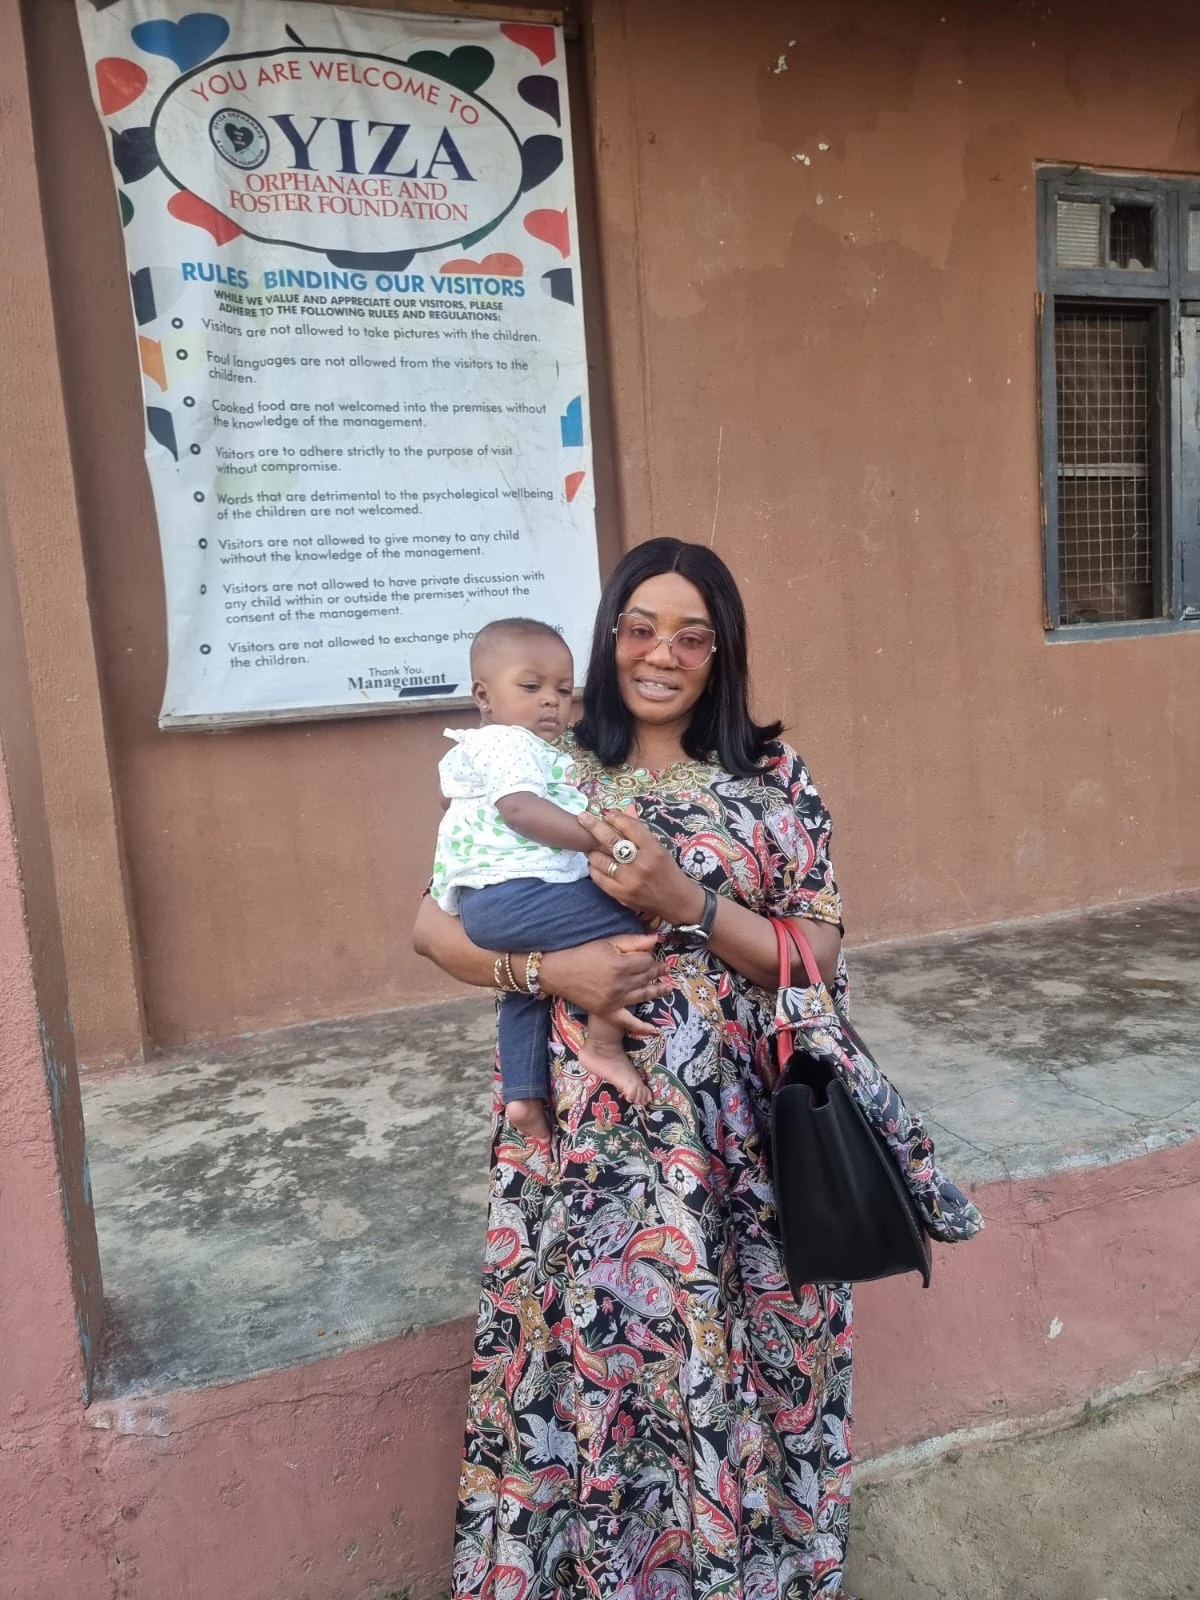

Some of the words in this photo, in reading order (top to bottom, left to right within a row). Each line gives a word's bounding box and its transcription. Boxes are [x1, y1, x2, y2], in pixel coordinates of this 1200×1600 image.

[191, 69, 247, 102] YOU
[258, 60, 302, 87] ARE
[309, 60, 441, 105] WELCOME
[449, 94, 479, 125] TO
[267, 113, 478, 182] YIZA
[246, 172, 393, 198] ORPHANAGE
[398, 181, 448, 201] AND
[229, 189, 313, 214] FOSTER
[318, 196, 468, 222] FOUNDATION
[181, 262, 249, 289] RULES
[263, 269, 368, 291] BINDING
[375, 273, 425, 293] OUR
[430, 275, 525, 297] VISITORS
[214, 289, 243, 304] WHILE
[246, 296, 263, 306] WE
[265, 293, 300, 304] VALUE
[303, 295, 327, 305] AND
[330, 296, 391, 308] APPRECIATE
[393, 299, 417, 309] OUR
[420, 299, 467, 310] VISITORS,
[469, 301, 503, 311] PLEASE
[219, 302, 257, 318] ADHERE
[260, 307, 274, 317] TO
[277, 305, 297, 315] THE
[300, 306, 366, 317] FOLLOWING
[368, 309, 400, 319] RULES
[402, 310, 426, 320] AND
[201, 317, 242, 337] Visitors
[246, 328, 266, 338] are
[270, 324, 291, 335] not
[295, 323, 344, 336] allowed
[348, 326, 360, 337] to
[364, 327, 389, 338] take
[393, 327, 440, 341] pictures
[443, 328, 468, 340] with
[471, 329, 489, 341] the
[493, 329, 541, 342] children.
[206, 350, 230, 365] Foul
[232, 354, 297, 371] languages
[300, 357, 321, 367] are
[325, 356, 345, 367] not
[349, 355, 396, 368] allowed
[400, 356, 428, 369] from
[432, 357, 450, 369] the
[454, 357, 493, 370] visitors
[496, 360, 507, 370] to
[511, 359, 529, 371] the
[208, 367, 257, 384] children.
[211, 399, 254, 414] Cooked
[258, 400, 286, 412] food
[290, 402, 311, 412] are
[315, 401, 334, 412] not
[338, 400, 400, 412] welcomed
[404, 401, 426, 413] into
[430, 401, 448, 413] the
[452, 402, 503, 415] premises
[506, 402, 547, 414] without
[213, 415, 229, 428] the
[232, 414, 299, 429] knowledge
[302, 415, 315, 427] of
[319, 415, 338, 427] the
[343, 417, 427, 429] management.
[215, 446, 255, 460] Visitors
[258, 447, 279, 457] are
[283, 446, 295, 457] to
[299, 445, 343, 457] adhere
[347, 445, 385, 459] strictly
[388, 446, 400, 456] to
[404, 446, 423, 456] the
[427, 447, 473, 459] purpose
[477, 444, 488, 456] of
[491, 445, 513, 456] visit
[216, 462, 257, 475] without
[261, 460, 342, 474] compromise.
[216, 492, 253, 506] Words
[257, 491, 281, 502] that
[285, 492, 306, 502] are
[311, 489, 381, 502] detrimental
[384, 490, 396, 500] to
[400, 489, 418, 500] the
[423, 488, 499, 502] psychological
[502, 488, 554, 501] wellbeing
[216, 508, 229, 520] of
[232, 508, 251, 520] the
[255, 505, 306, 517] children
[310, 507, 331, 516] are
[335, 505, 355, 516] not
[359, 504, 422, 515] welcomed.
[218, 538, 263, 550] Visitors
[267, 538, 289, 547] are
[292, 537, 313, 547] not
[316, 534, 365, 546] allowed
[369, 535, 381, 545] to
[384, 534, 408, 546] give
[412, 534, 451, 546] money
[455, 532, 466, 542] to
[470, 532, 490, 543] any
[493, 530, 520, 541] child
[220, 551, 267, 565] without
[271, 551, 291, 563] the
[295, 549, 363, 562] knowledge
[366, 548, 379, 559] of
[382, 548, 400, 559] the
[404, 546, 485, 559] management.
[222, 582, 268, 594] Visitors
[272, 583, 293, 592] are
[297, 581, 317, 591] not
[321, 578, 369, 590] allowed
[373, 578, 385, 588] to
[389, 576, 417, 588] have
[421, 575, 460, 588] private
[463, 572, 519, 584] discussion
[522, 570, 545, 582] with
[224, 600, 247, 611] any
[251, 595, 281, 608] child
[285, 594, 323, 606] within
[327, 595, 340, 604] or
[344, 591, 388, 604] outside
[391, 590, 410, 601] the
[414, 589, 465, 603] premises
[467, 586, 509, 598] without
[512, 585, 530, 596] the
[226, 611, 275, 624] consent
[279, 609, 292, 621] of
[295, 609, 315, 620] the
[319, 606, 403, 620] management.
[228, 641, 275, 653] Visitors
[278, 641, 299, 651] are
[303, 639, 323, 649] not
[327, 635, 375, 648] allowed
[378, 635, 390, 645] to
[394, 632, 450, 645] exchange
[453, 629, 476, 642] pho
[230, 657, 251, 668] the
[255, 654, 310, 667] children.
[369, 666, 400, 677] Thank
[403, 665, 425, 675] You.
[347, 672, 447, 690] Management
